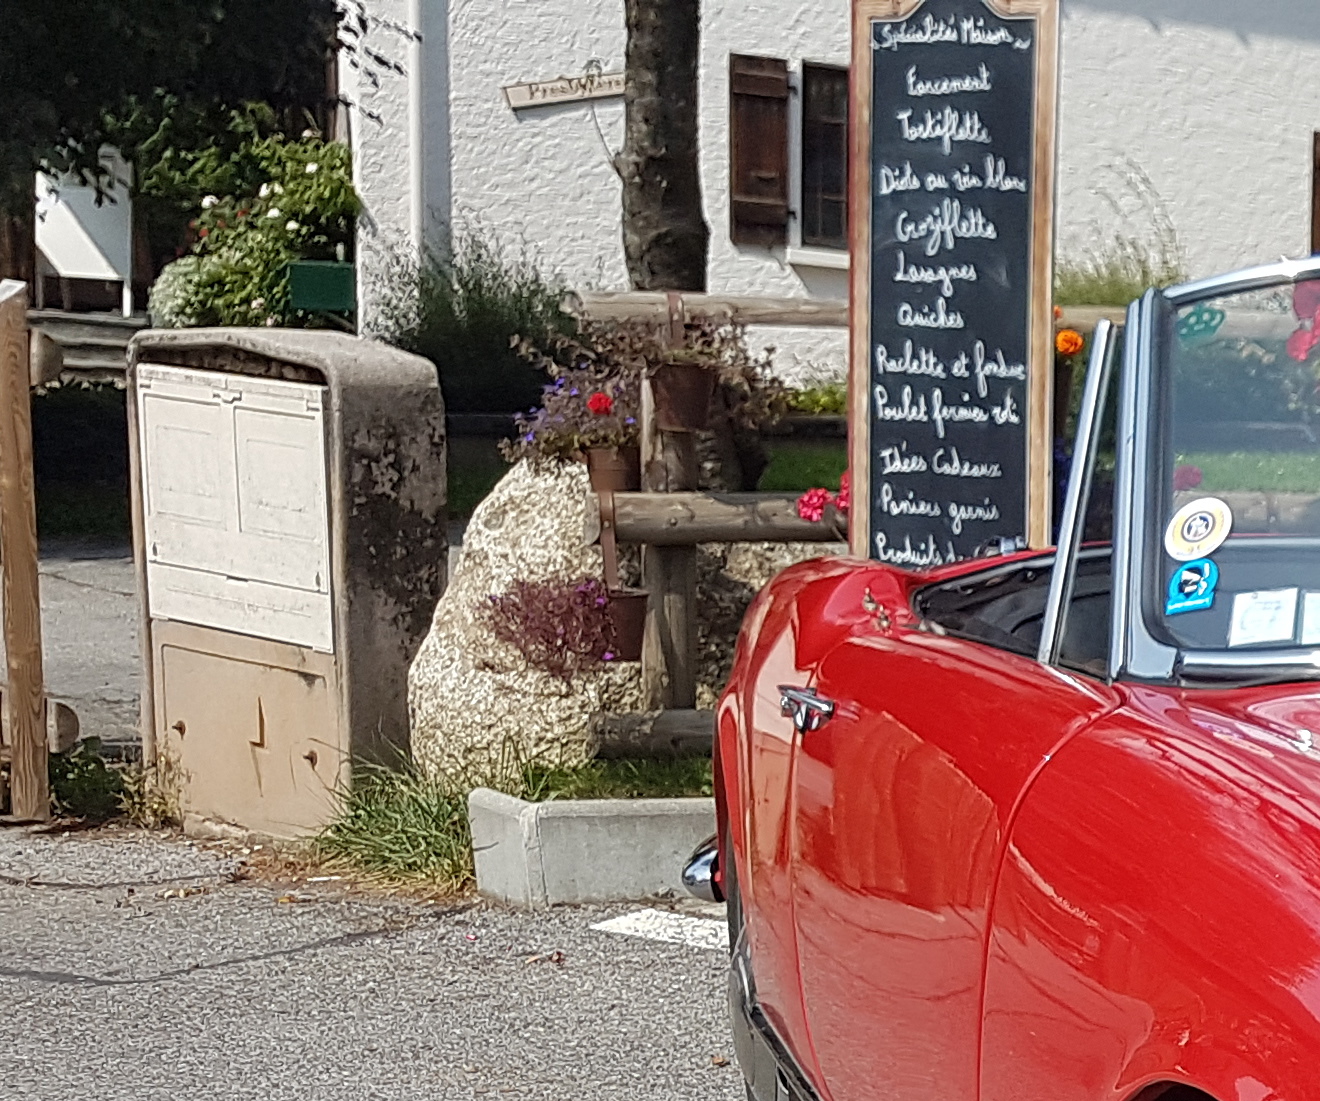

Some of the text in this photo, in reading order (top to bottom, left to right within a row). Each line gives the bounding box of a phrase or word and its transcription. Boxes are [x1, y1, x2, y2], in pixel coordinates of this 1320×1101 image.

[897, 106, 992, 155] Tartiflette
[925, 172, 949, 192] au
[952, 164, 983, 191] vin
[894, 250, 977, 297] Lasagnes
[898, 297, 965, 329] Quiches
[952, 351, 969, 377] et
[974, 340, 1026, 398] fondue
[874, 384, 928, 422] Poulet
[880, 441, 927, 475] Idées
[881, 483, 999, 535] Paniers garnis
[875, 531, 943, 567] Produits
